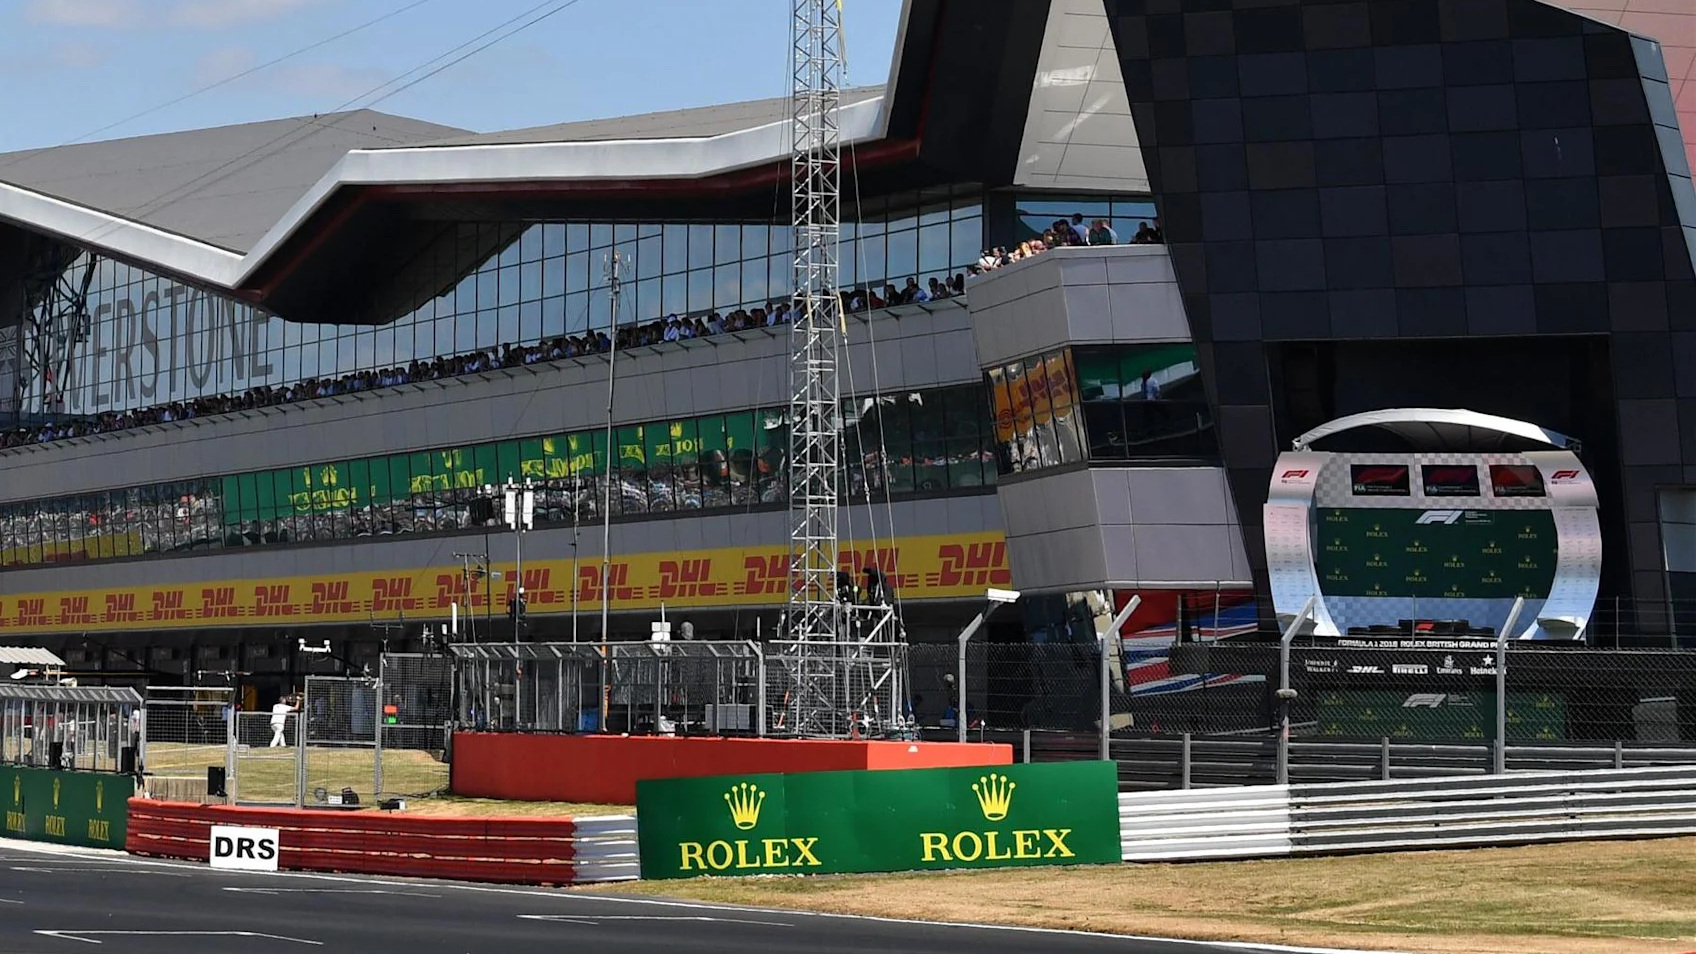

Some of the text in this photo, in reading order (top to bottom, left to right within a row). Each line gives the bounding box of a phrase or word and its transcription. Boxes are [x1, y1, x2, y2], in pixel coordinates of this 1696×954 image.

[1281, 470, 1309, 478] F1
[1551, 470, 1581, 479] F1
[1415, 510, 1464, 524] F1
[17, 599, 47, 626] DHL
[60, 597, 91, 625] DHL
[106, 593, 137, 622] DHL
[153, 591, 186, 620] DHL
[202, 588, 238, 618] DHL
[255, 585, 293, 616] DHL
[311, 581, 354, 614] DHL
[372, 577, 417, 611] DHL
[436, 573, 482, 608] DHL
[579, 564, 632, 601] DHL
[659, 559, 716, 598] DHL
[1338, 639, 1375, 647] FORMULA
[1379, 640, 1398, 648] 2018
[1400, 640, 1426, 648] ROLEX
[1459, 641, 1489, 649] GRAND
[1350, 666, 1380, 674] DHL
[1392, 664, 1428, 674] PIRELLI
[1402, 694, 1447, 708] F1
[6, 810, 26, 832] ROLEX
[45, 815, 65, 836] ROLEX
[88, 819, 110, 841] ROLEX
[215, 836, 275, 860] DRS
[679, 828, 1075, 870] ROLEX ROLEX
